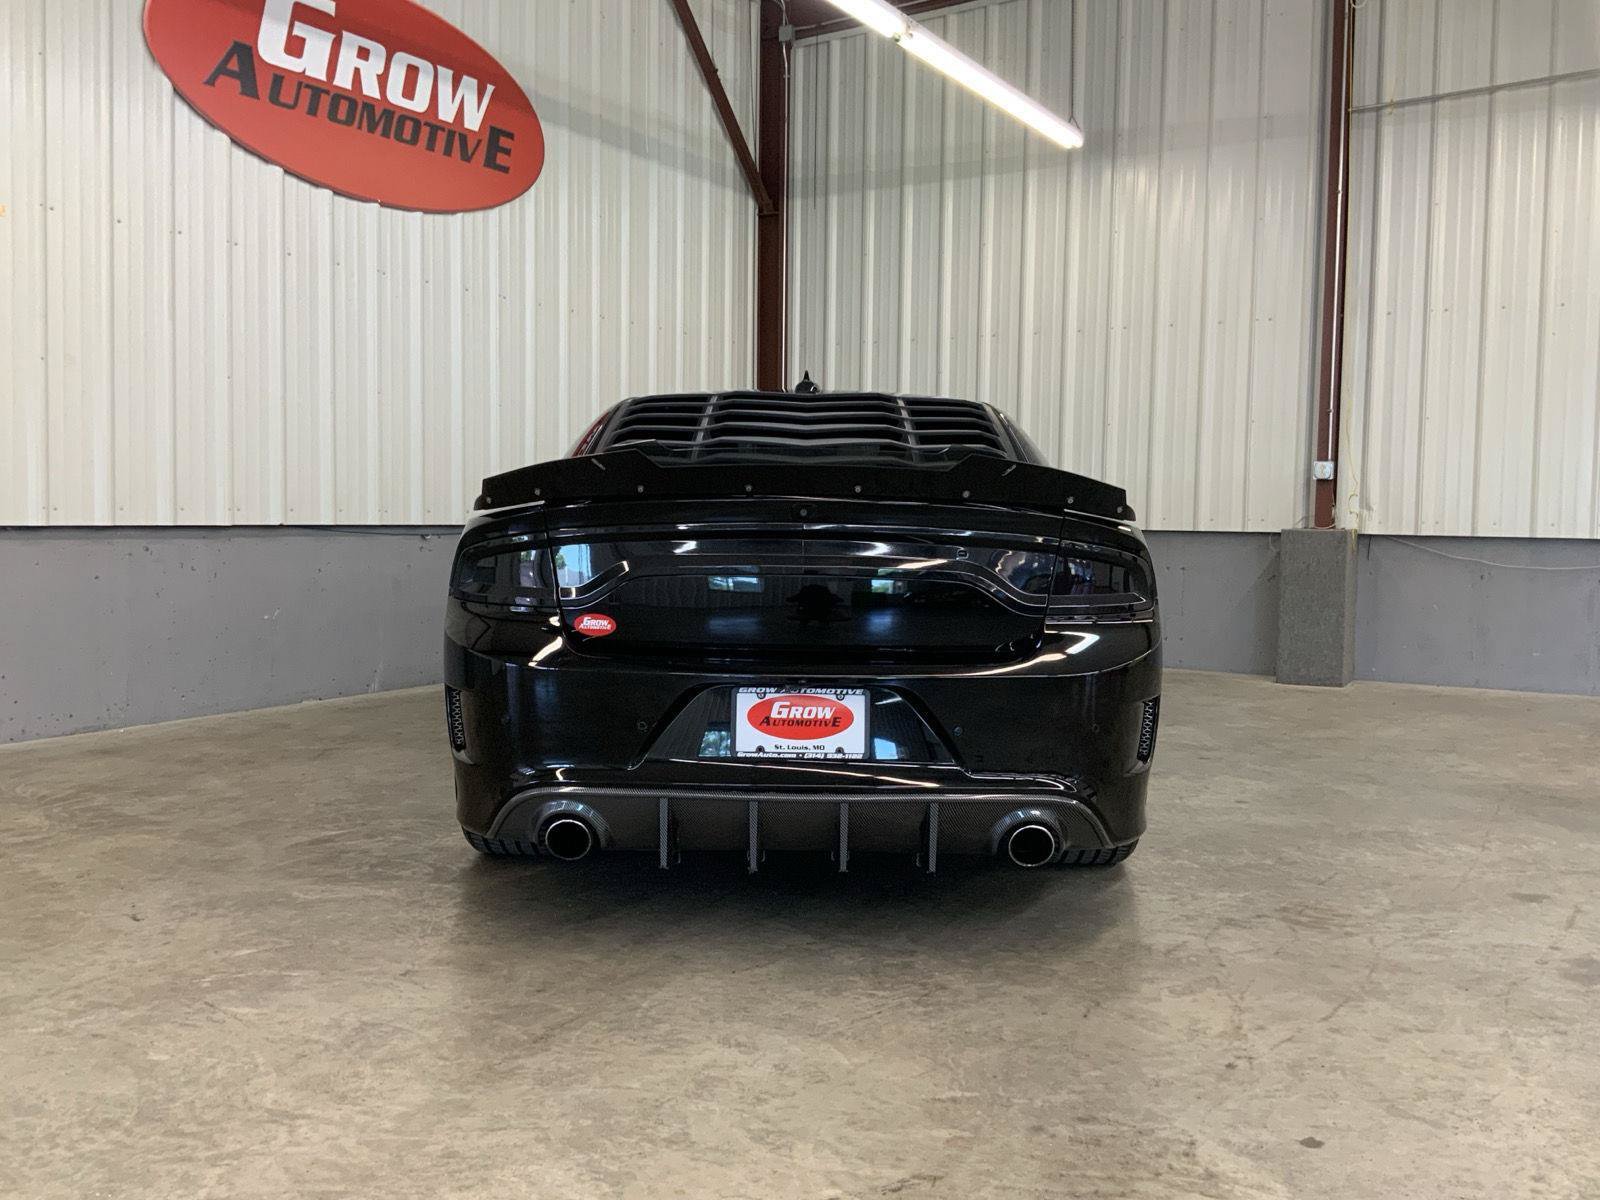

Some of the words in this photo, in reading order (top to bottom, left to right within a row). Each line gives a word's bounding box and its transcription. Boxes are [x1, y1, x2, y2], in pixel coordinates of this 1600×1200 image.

[257, 0, 495, 132] GROW
[203, 40, 515, 174] AUTOMOTIVE
[582, 616, 609, 626] GROW
[780, 687, 864, 695] TOMOTIVE
[770, 701, 836, 719] GROW
[759, 716, 842, 728] AUTOMOTIVE
